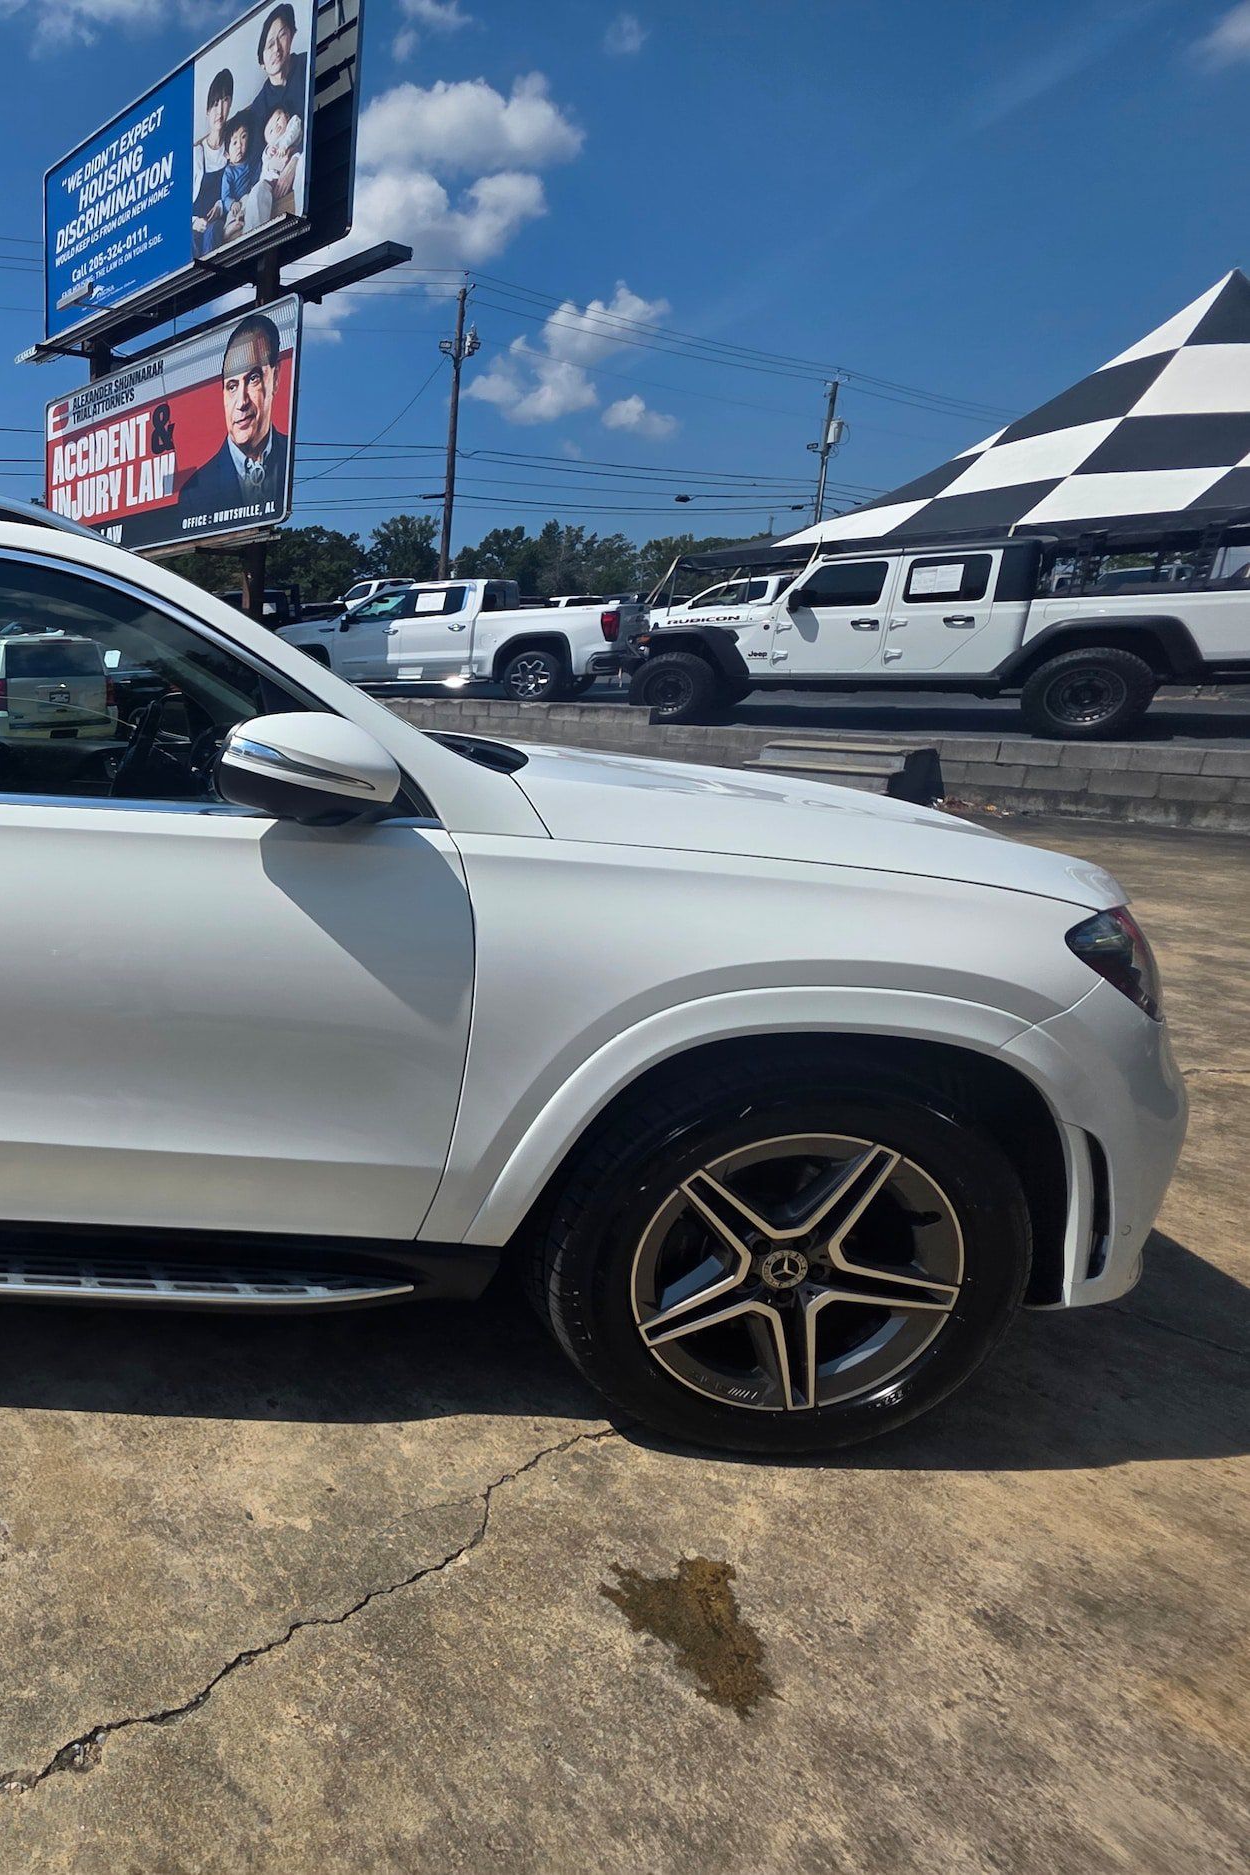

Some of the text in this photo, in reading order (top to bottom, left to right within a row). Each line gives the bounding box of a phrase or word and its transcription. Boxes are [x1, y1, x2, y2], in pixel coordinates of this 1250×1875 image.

[120, 105, 164, 155] EXPECT
[56, 151, 173, 254] DISCRIMINATION
[79, 145, 143, 212] HOUSING
[55, 246, 75, 268] WOULD
[75, 237, 90, 254] KEEP
[90, 230, 100, 244] US
[99, 218, 117, 238] FROM
[117, 210, 131, 226] OUR
[131, 198, 148, 218] NEW
[71, 225, 148, 282] Call 205-324-0111
[95, 267, 105, 280] THE
[105, 259, 118, 273] LAW
[118, 256, 124, 266] IS
[124, 251, 132, 262] ON
[132, 242, 148, 257] YOUR
[148, 233, 163, 248] SIDE.
[72, 360, 164, 411] ALEXANDER SHUNNARAH
[73, 387, 135, 424] TRIAL ATTORNEYS
[52, 403, 175, 486] ACCIDENT &
[52, 452, 175, 521] INJURY LAW
[213, 504, 262, 523] HUNTSVILLE,
[264, 501, 275, 514] AL
[667, 615, 740, 625] RUBICON
